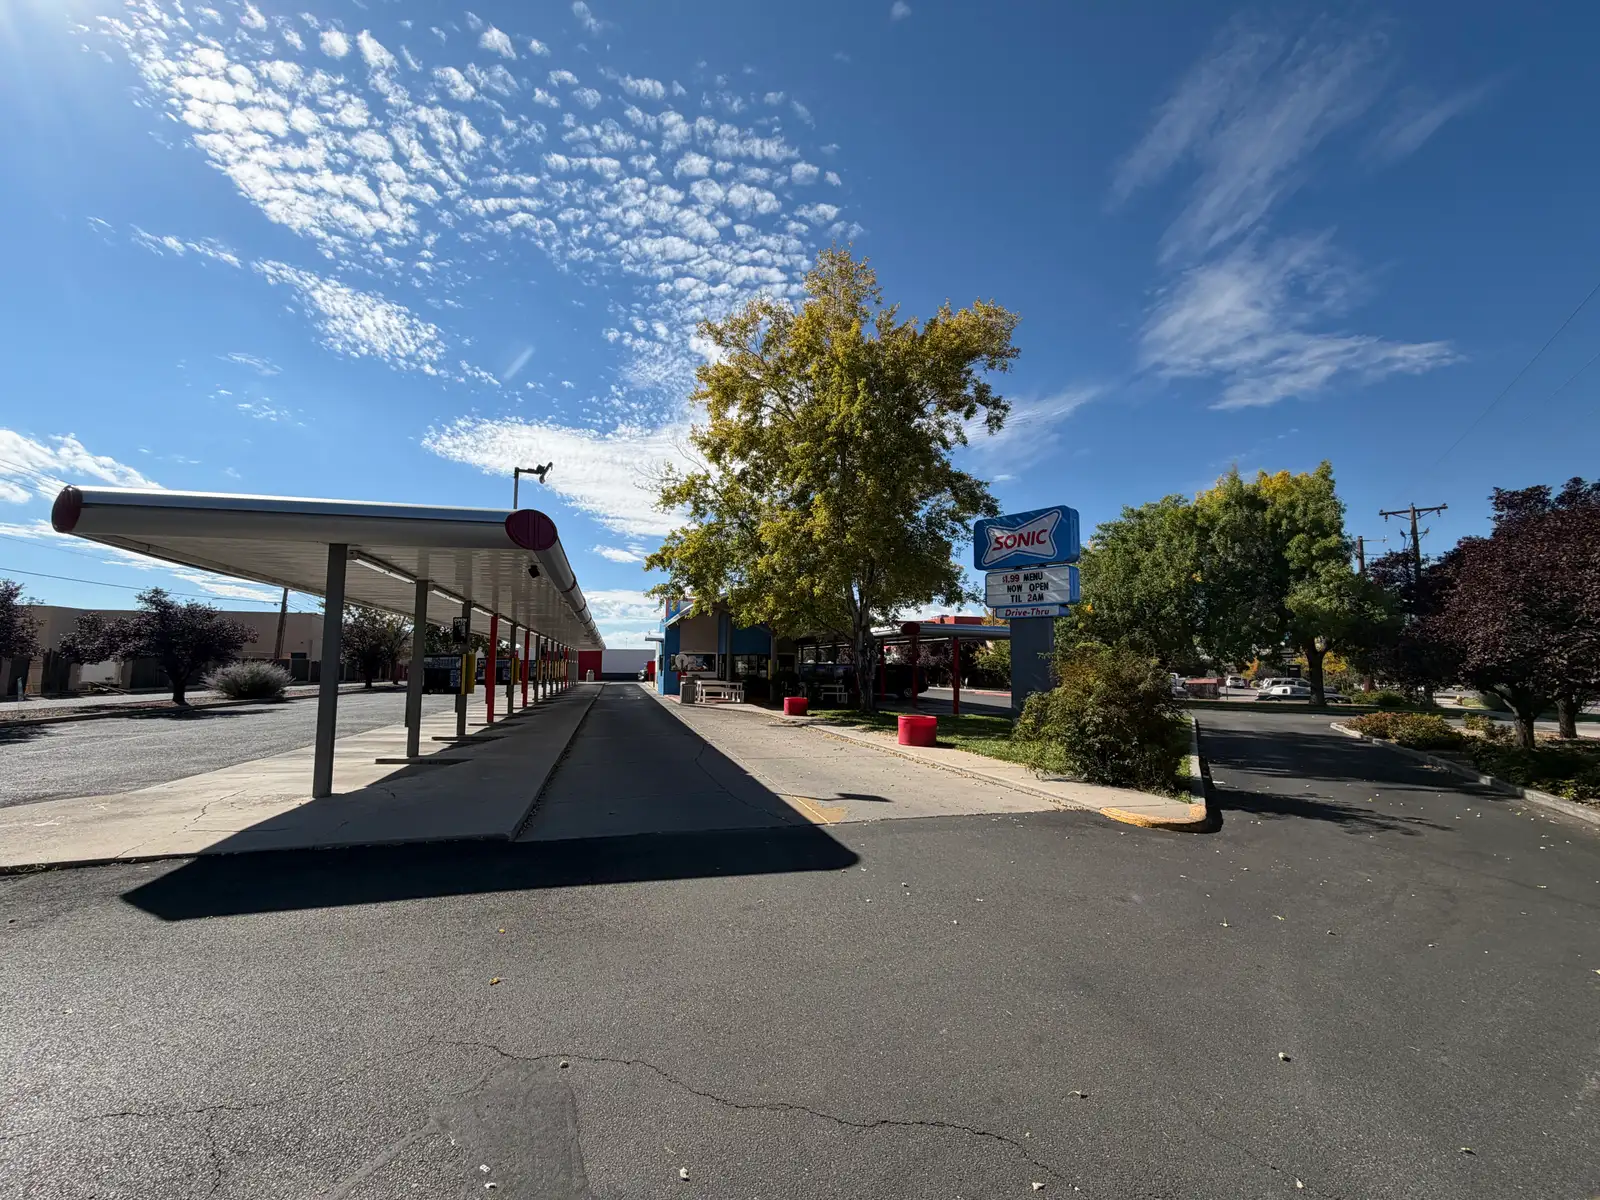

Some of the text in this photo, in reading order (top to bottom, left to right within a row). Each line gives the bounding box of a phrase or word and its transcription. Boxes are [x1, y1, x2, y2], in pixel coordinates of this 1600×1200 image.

[992, 529, 1048, 551] SONIC
[1002, 572, 1043, 583] $1.99 MENU
[1007, 582, 1049, 592] NOW OPEN
[1010, 593, 1044, 603] TIL 2AM
[1005, 608, 1050, 617] Drive-Thru
